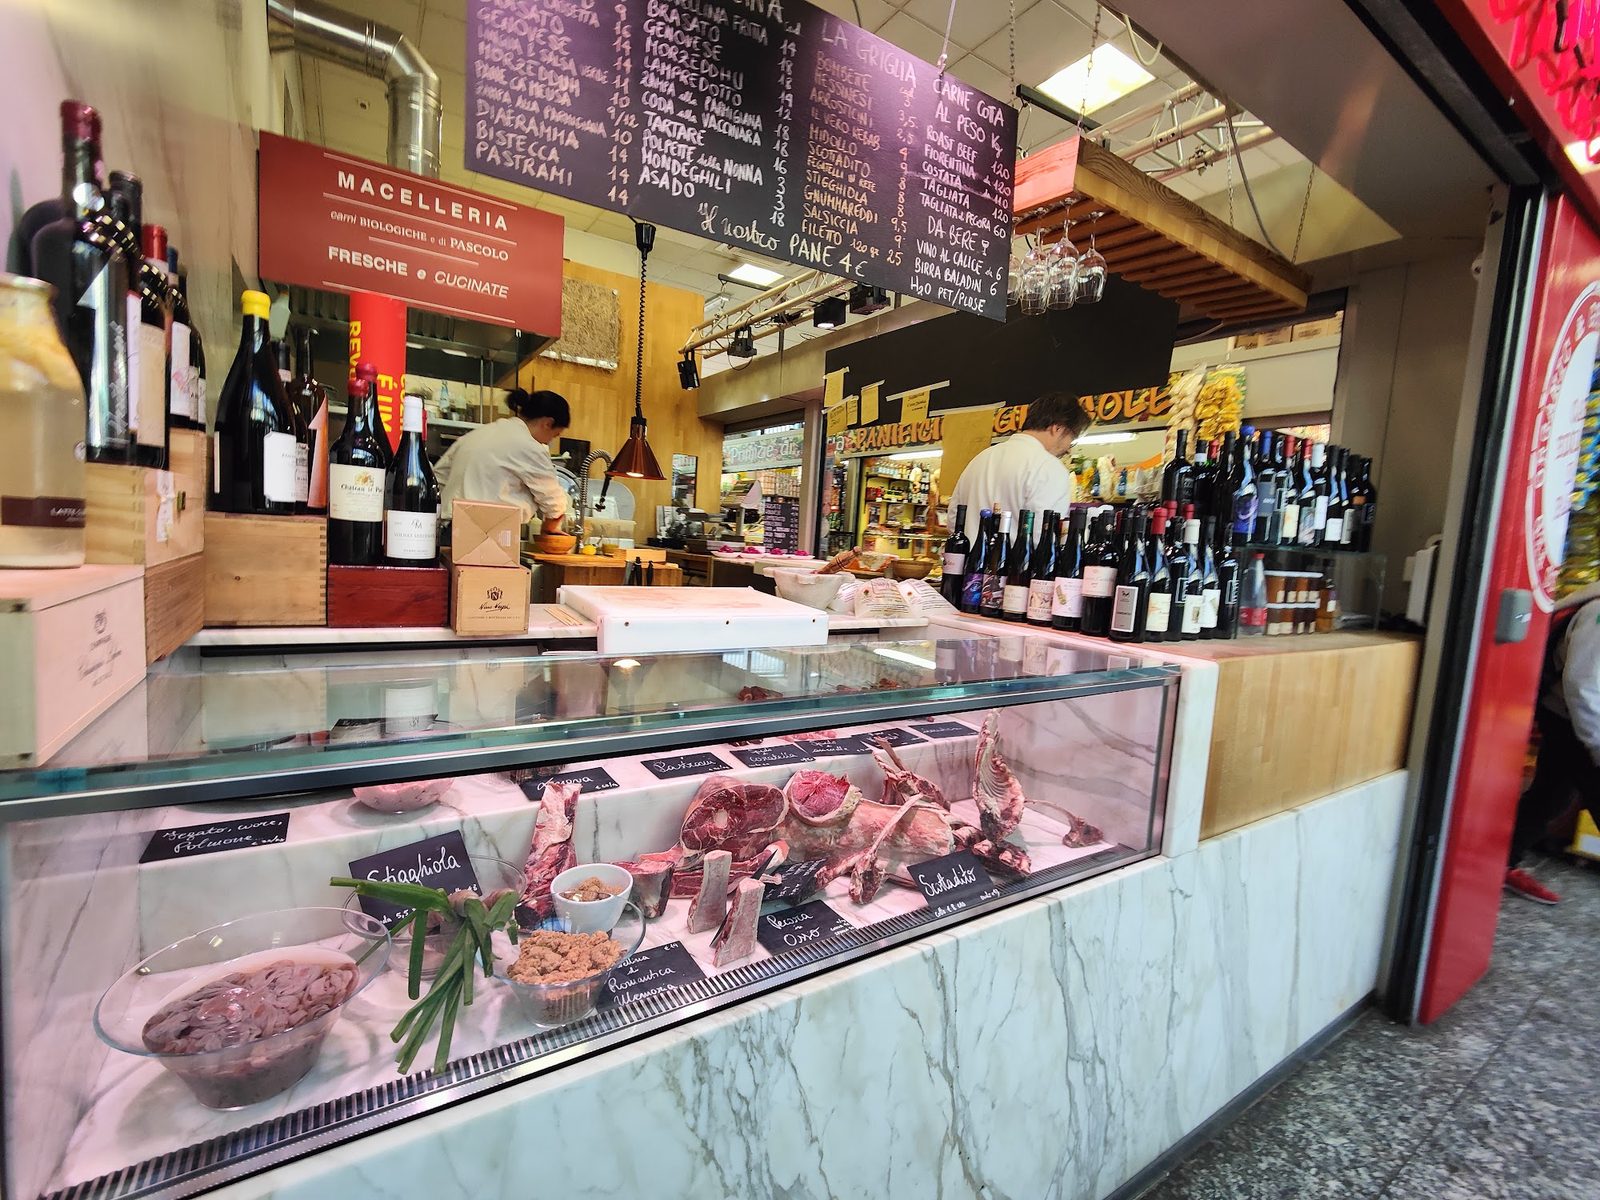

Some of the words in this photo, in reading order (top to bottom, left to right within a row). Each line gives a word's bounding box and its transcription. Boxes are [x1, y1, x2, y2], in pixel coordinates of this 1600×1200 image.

[642, 18, 725, 62] GENOVESE
[646, 0, 721, 43] BRASATO
[820, 18, 849, 50] LA
[855, 36, 918, 89] GRIGLIA
[641, 90, 675, 116] CODA
[932, 79, 975, 112] CARNE
[475, 119, 561, 165] BISTECCA
[643, 110, 707, 147] TARTARE
[772, 156, 788, 175] 16
[934, 100, 952, 124] AL
[956, 114, 987, 143] PESO
[642, 128, 697, 164] POLPETTE
[722, 157, 764, 187] NONNA
[807, 140, 872, 178] SCOTTADITO
[924, 143, 977, 180] FIORENTINA
[926, 124, 956, 152] ROAST
[956, 142, 979, 164] BEEF
[475, 141, 573, 187] PASTRAMI
[607, 185, 629, 207] 14
[641, 146, 732, 195] MONDEGHILI
[805, 169, 869, 206] STIGGHIOLA
[922, 160, 963, 191] COSTATA
[337, 169, 509, 232] MACELLERIA
[638, 165, 696, 199] ASADO
[769, 210, 786, 228] 18
[919, 192, 958, 221] TAGLIATA
[992, 223, 1007, 239] 60
[920, 175, 971, 210] TAGLIATA
[991, 207, 1010, 224] 120
[330, 208, 358, 226] carni
[359, 215, 428, 242] BIOLOGICHE
[437, 235, 448, 247] di
[449, 236, 510, 262] PASCOLO
[802, 202, 859, 236] SALSICCIA
[927, 215, 948, 240] DA
[949, 223, 979, 252] BERE
[788, 232, 837, 268] PANE
[838, 252, 853, 274] 4
[801, 219, 842, 246] FILETTO
[886, 249, 904, 266] 25
[916, 238, 938, 259] VINO
[940, 246, 952, 264] AL
[953, 251, 985, 276] CALICE
[995, 266, 1004, 281] 6
[327, 244, 409, 277] FRESCHE
[433, 269, 511, 300] CUCINATE
[914, 256, 942, 280] BIRRA
[944, 267, 983, 294] BALADIN
[989, 281, 999, 296] 6
[783, 926, 821, 947] Osso
[607, 967, 677, 994] Romantica
